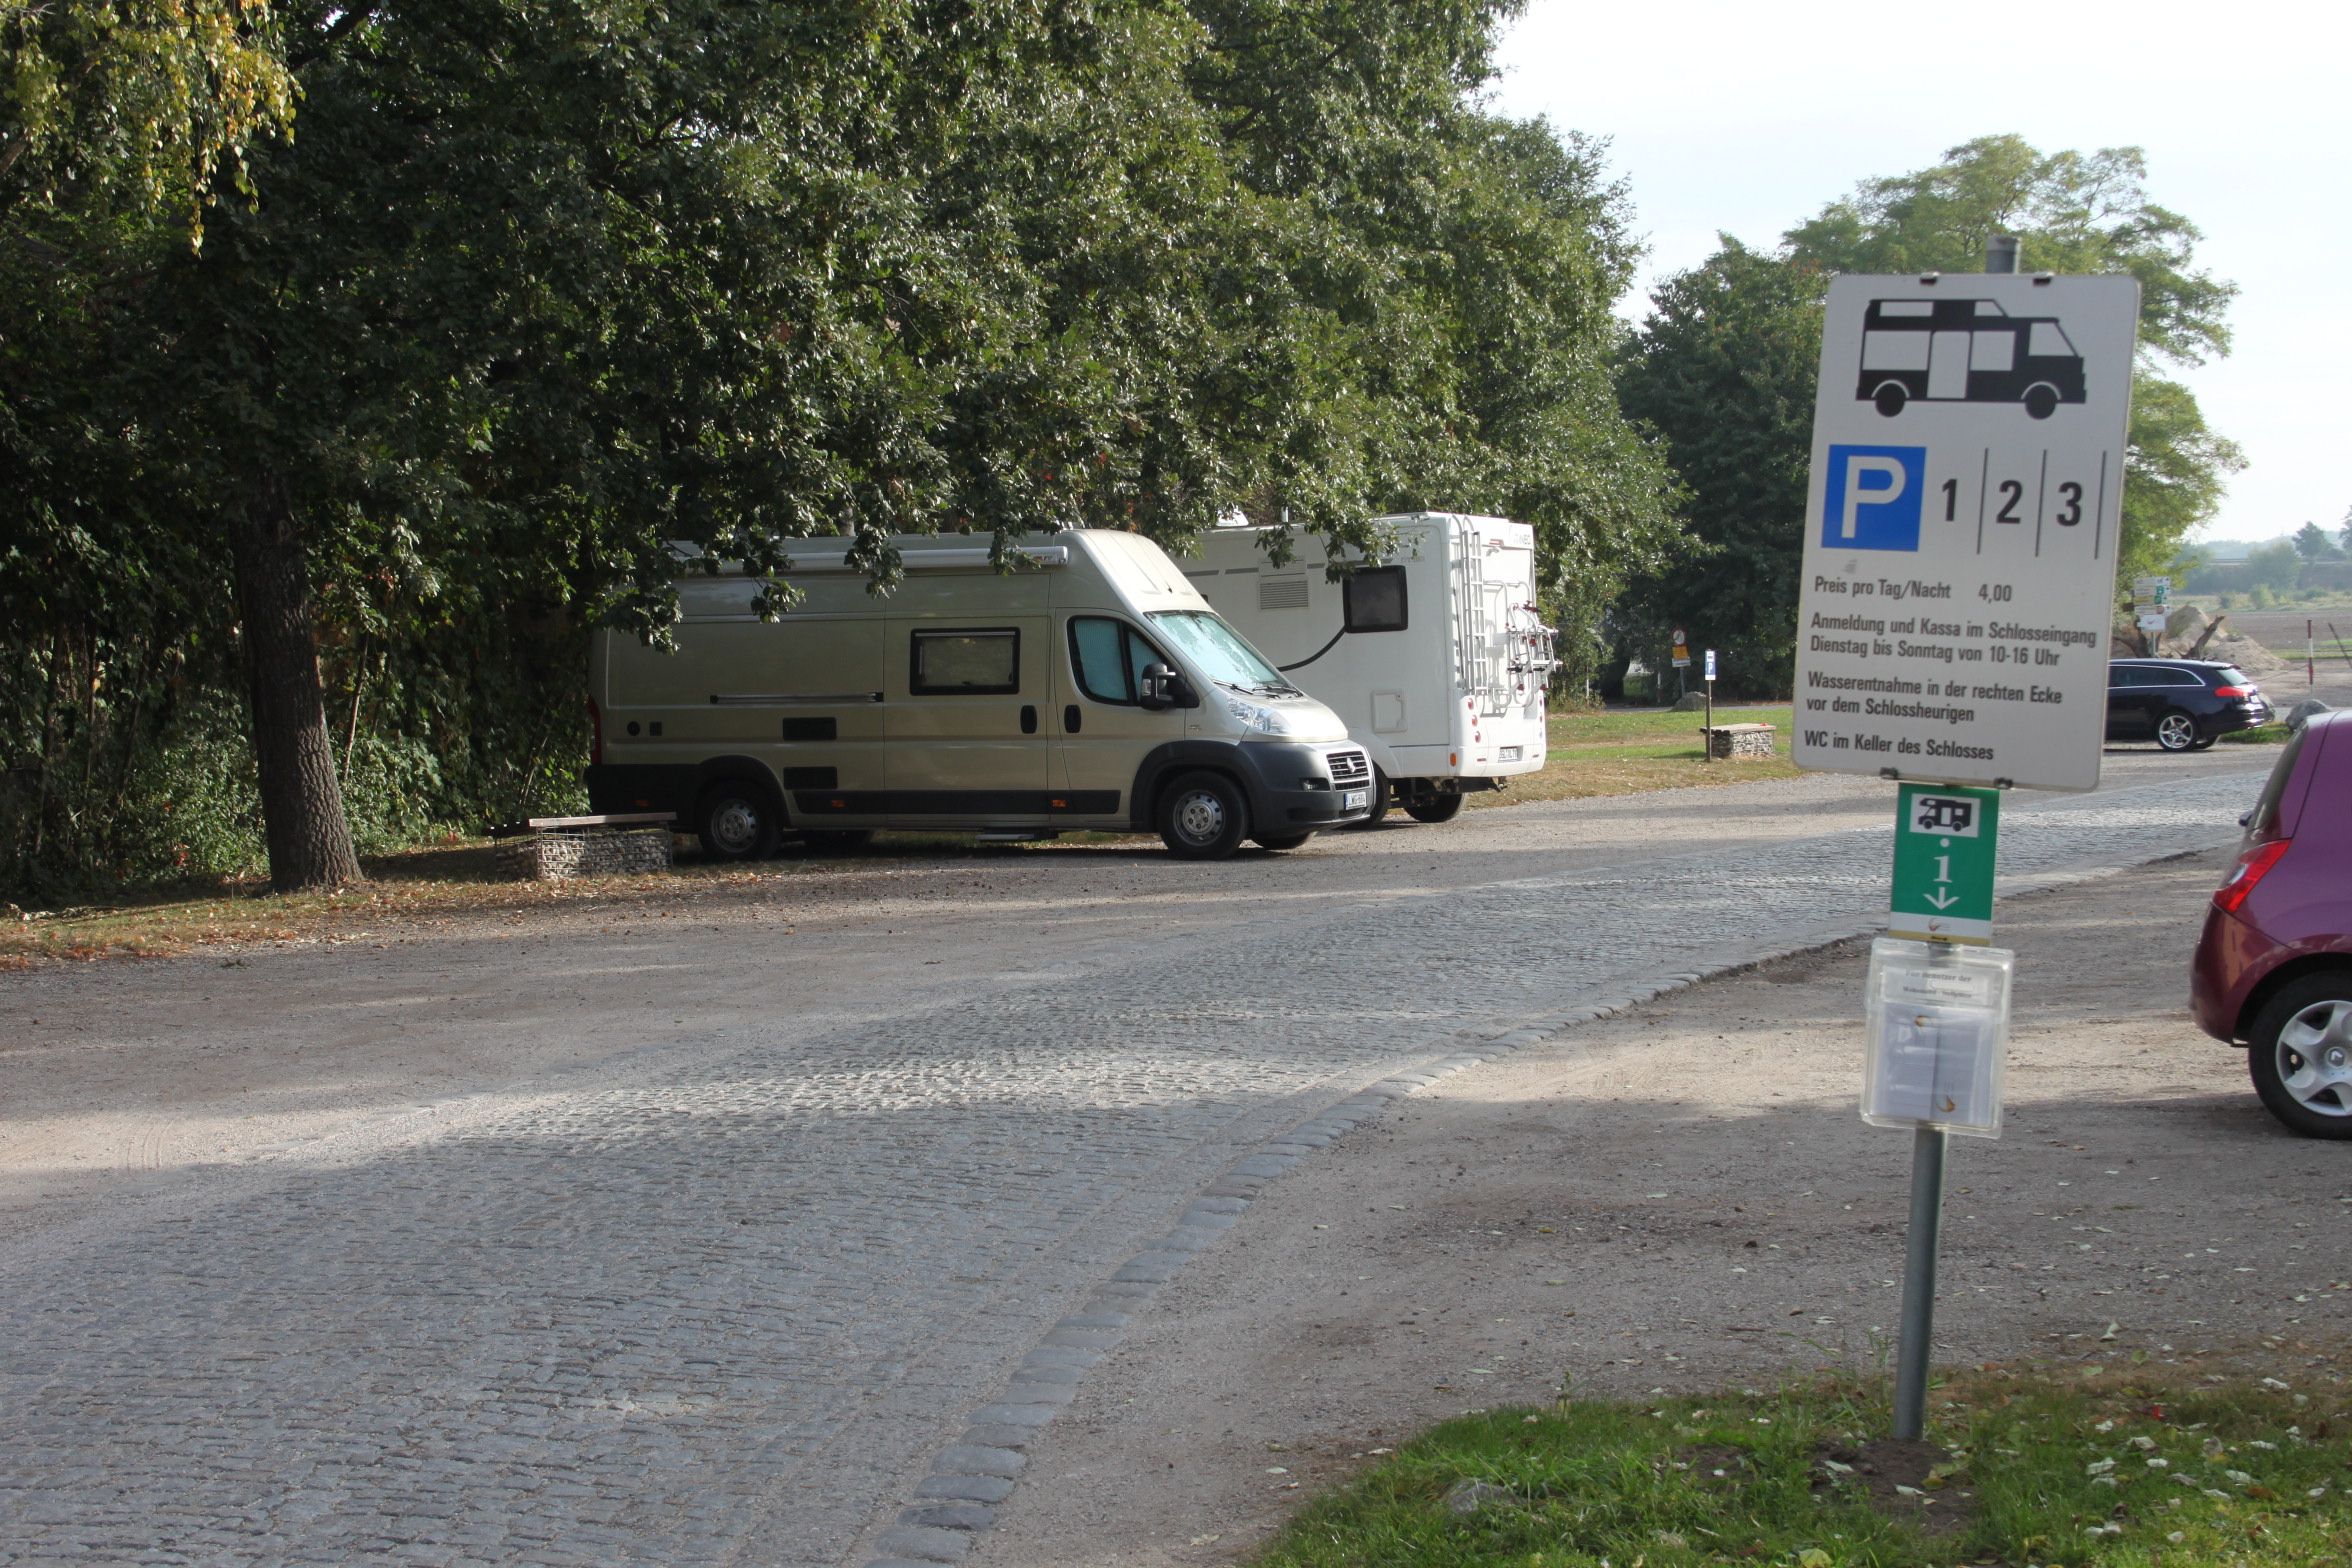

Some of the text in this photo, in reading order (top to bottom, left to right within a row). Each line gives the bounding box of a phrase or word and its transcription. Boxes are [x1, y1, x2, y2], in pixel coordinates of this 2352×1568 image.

[1841, 455, 1906, 538] P
[1942, 479, 2082, 526] 1 2 3
[1815, 576, 2012, 603] Preis pro Tag/Nacht 4,00
[1811, 612, 2097, 648] Anmeldung und Kassa im Schlosseingang
[1810, 635, 2060, 665] Dienstag bis Sonntag von 10-16 Uhr
[1808, 671, 2062, 704] Wasserentnahme in der rechten Ecke
[1806, 696, 1974, 724] vor dem Schlossheurigen
[1804, 730, 1994, 760] WC im Keller des Schlosses
